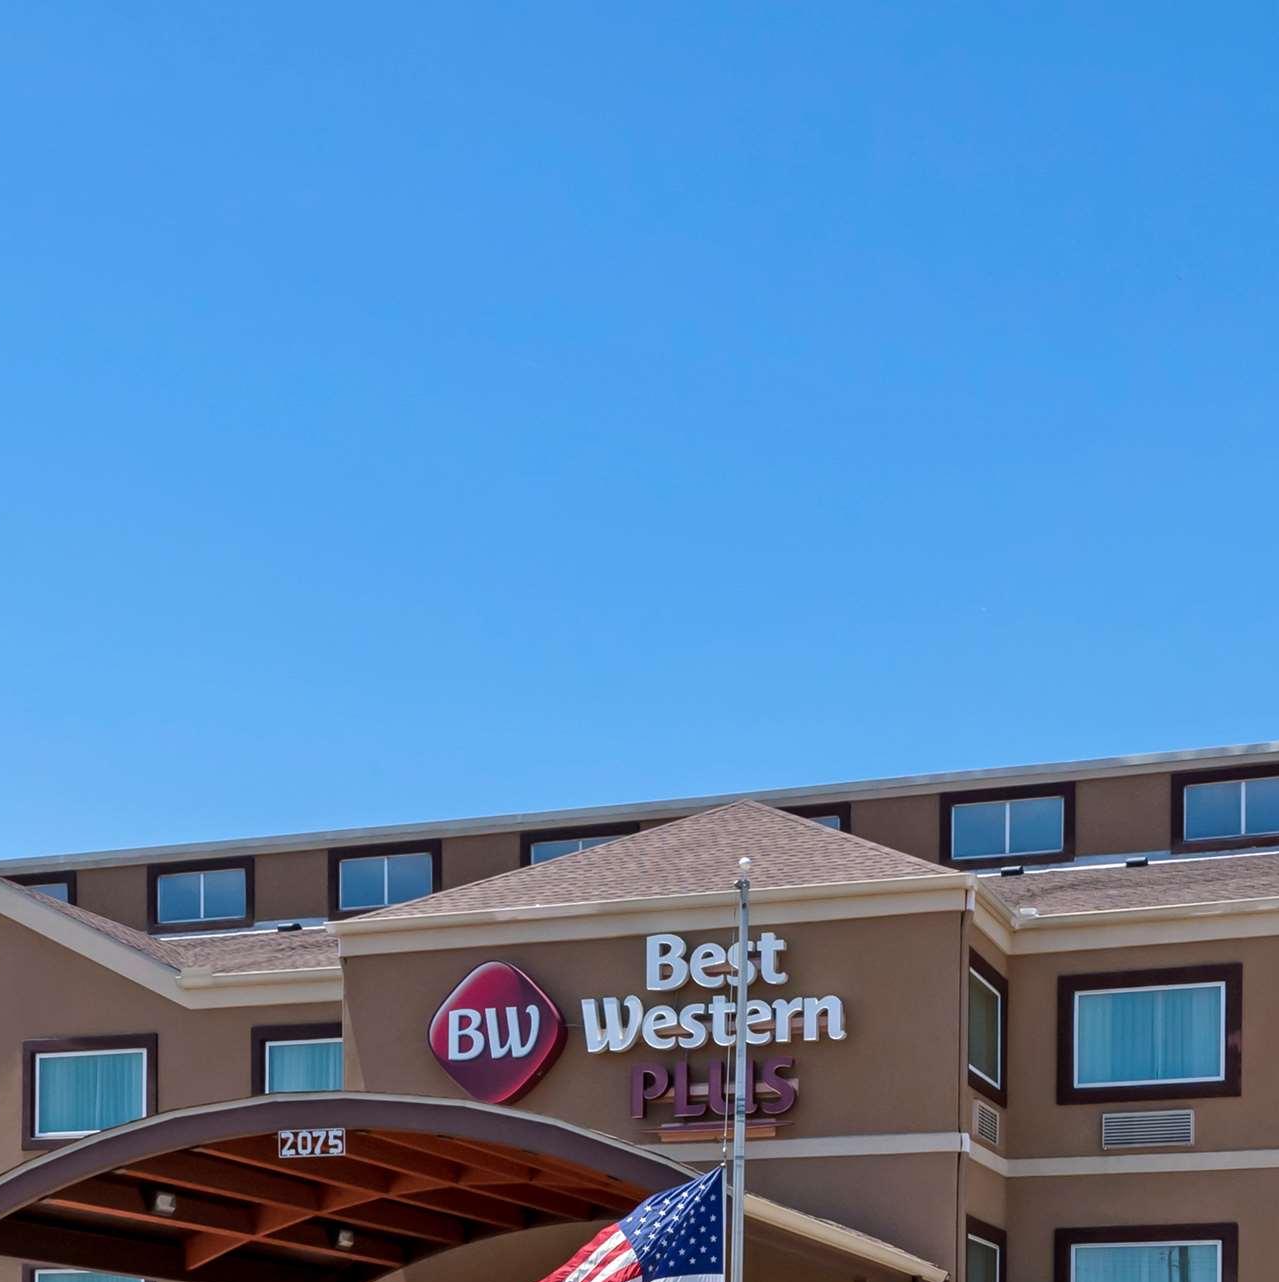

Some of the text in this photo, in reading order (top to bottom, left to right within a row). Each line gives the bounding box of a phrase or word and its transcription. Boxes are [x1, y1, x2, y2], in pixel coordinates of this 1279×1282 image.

[645, 931, 789, 992] Best
[447, 1003, 541, 1061] BW
[580, 993, 847, 1055] Western
[629, 1055, 797, 1119] PLUS
[280, 1130, 343, 1157] 2075
